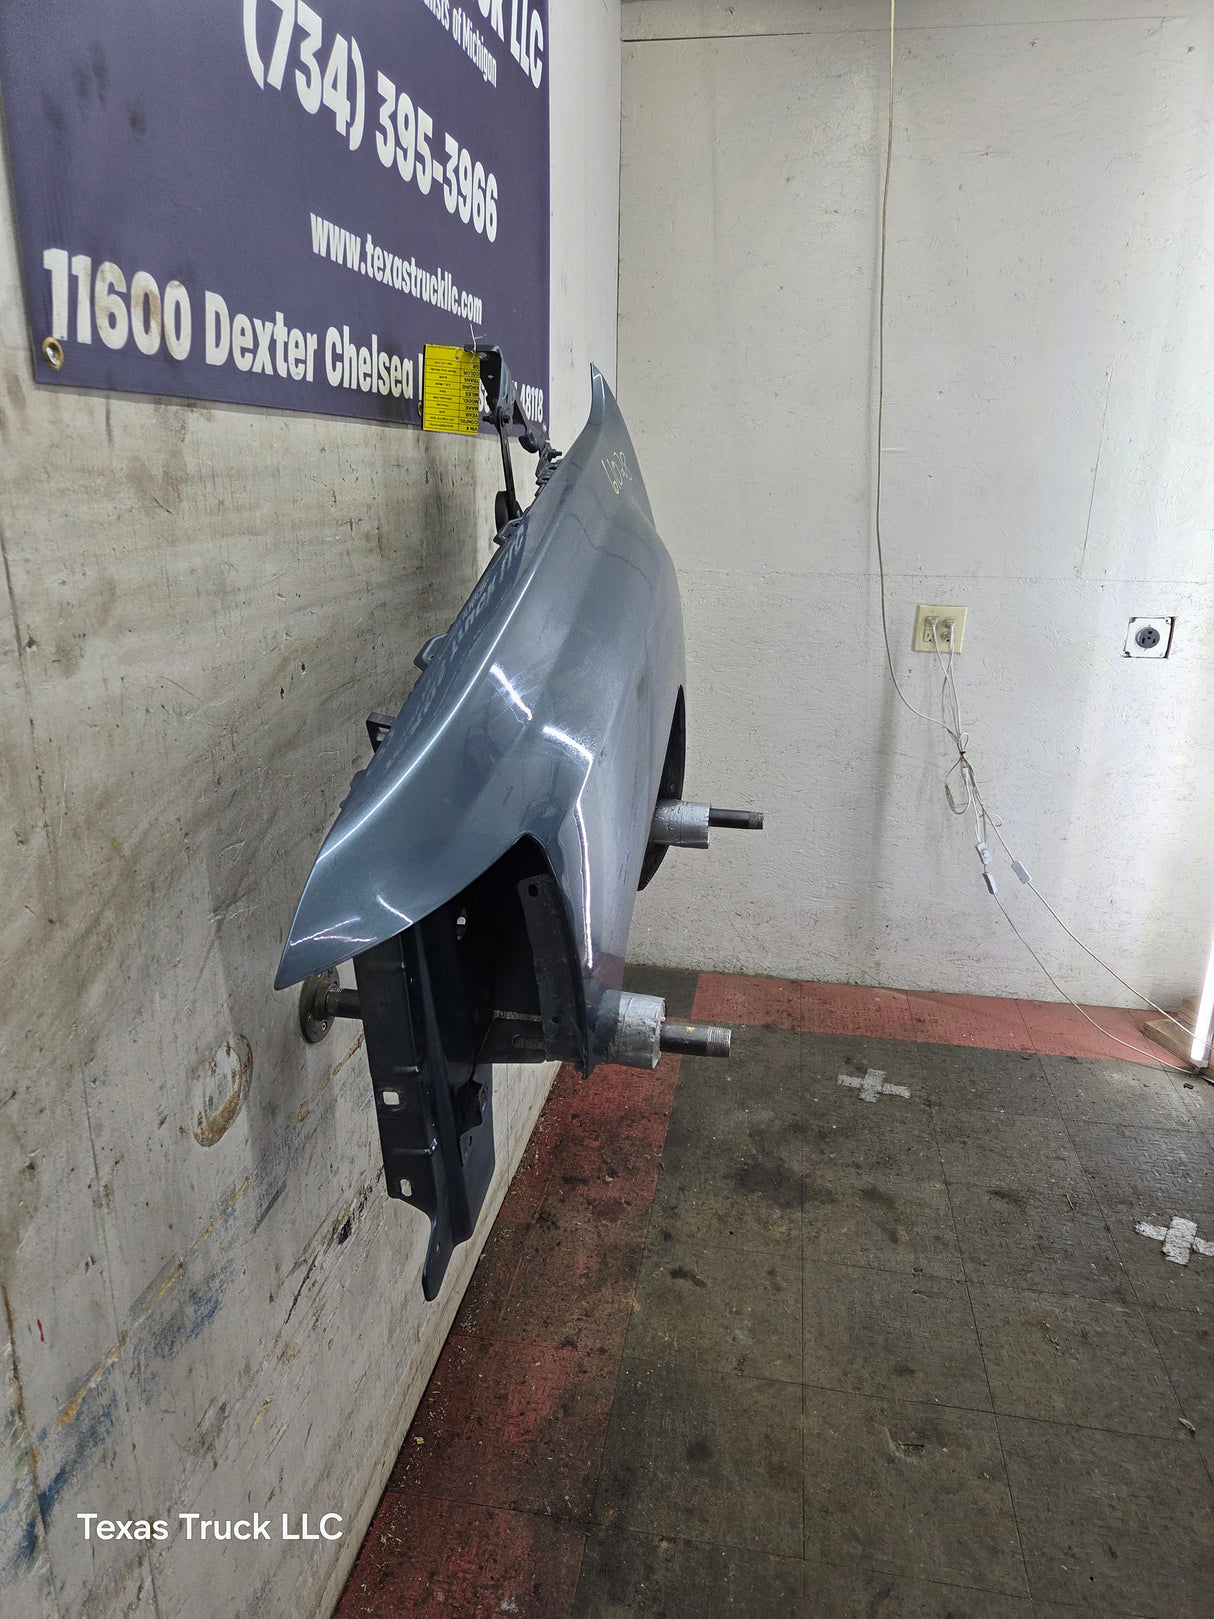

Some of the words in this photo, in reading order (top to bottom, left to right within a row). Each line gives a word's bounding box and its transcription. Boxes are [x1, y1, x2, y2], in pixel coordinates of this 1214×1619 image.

[452, 7, 462, 45] of
[462, 11, 497, 88] Michigan
[510, 0, 543, 88] LLC
[243, 0, 365, 151] (734)
[375, 69, 498, 242] 395-3966
[43, 247, 192, 361] 11600
[205, 290, 317, 382] Dexter
[325, 325, 413, 400] Chelsea
[310, 212, 483, 325] www.texastruckllc.com
